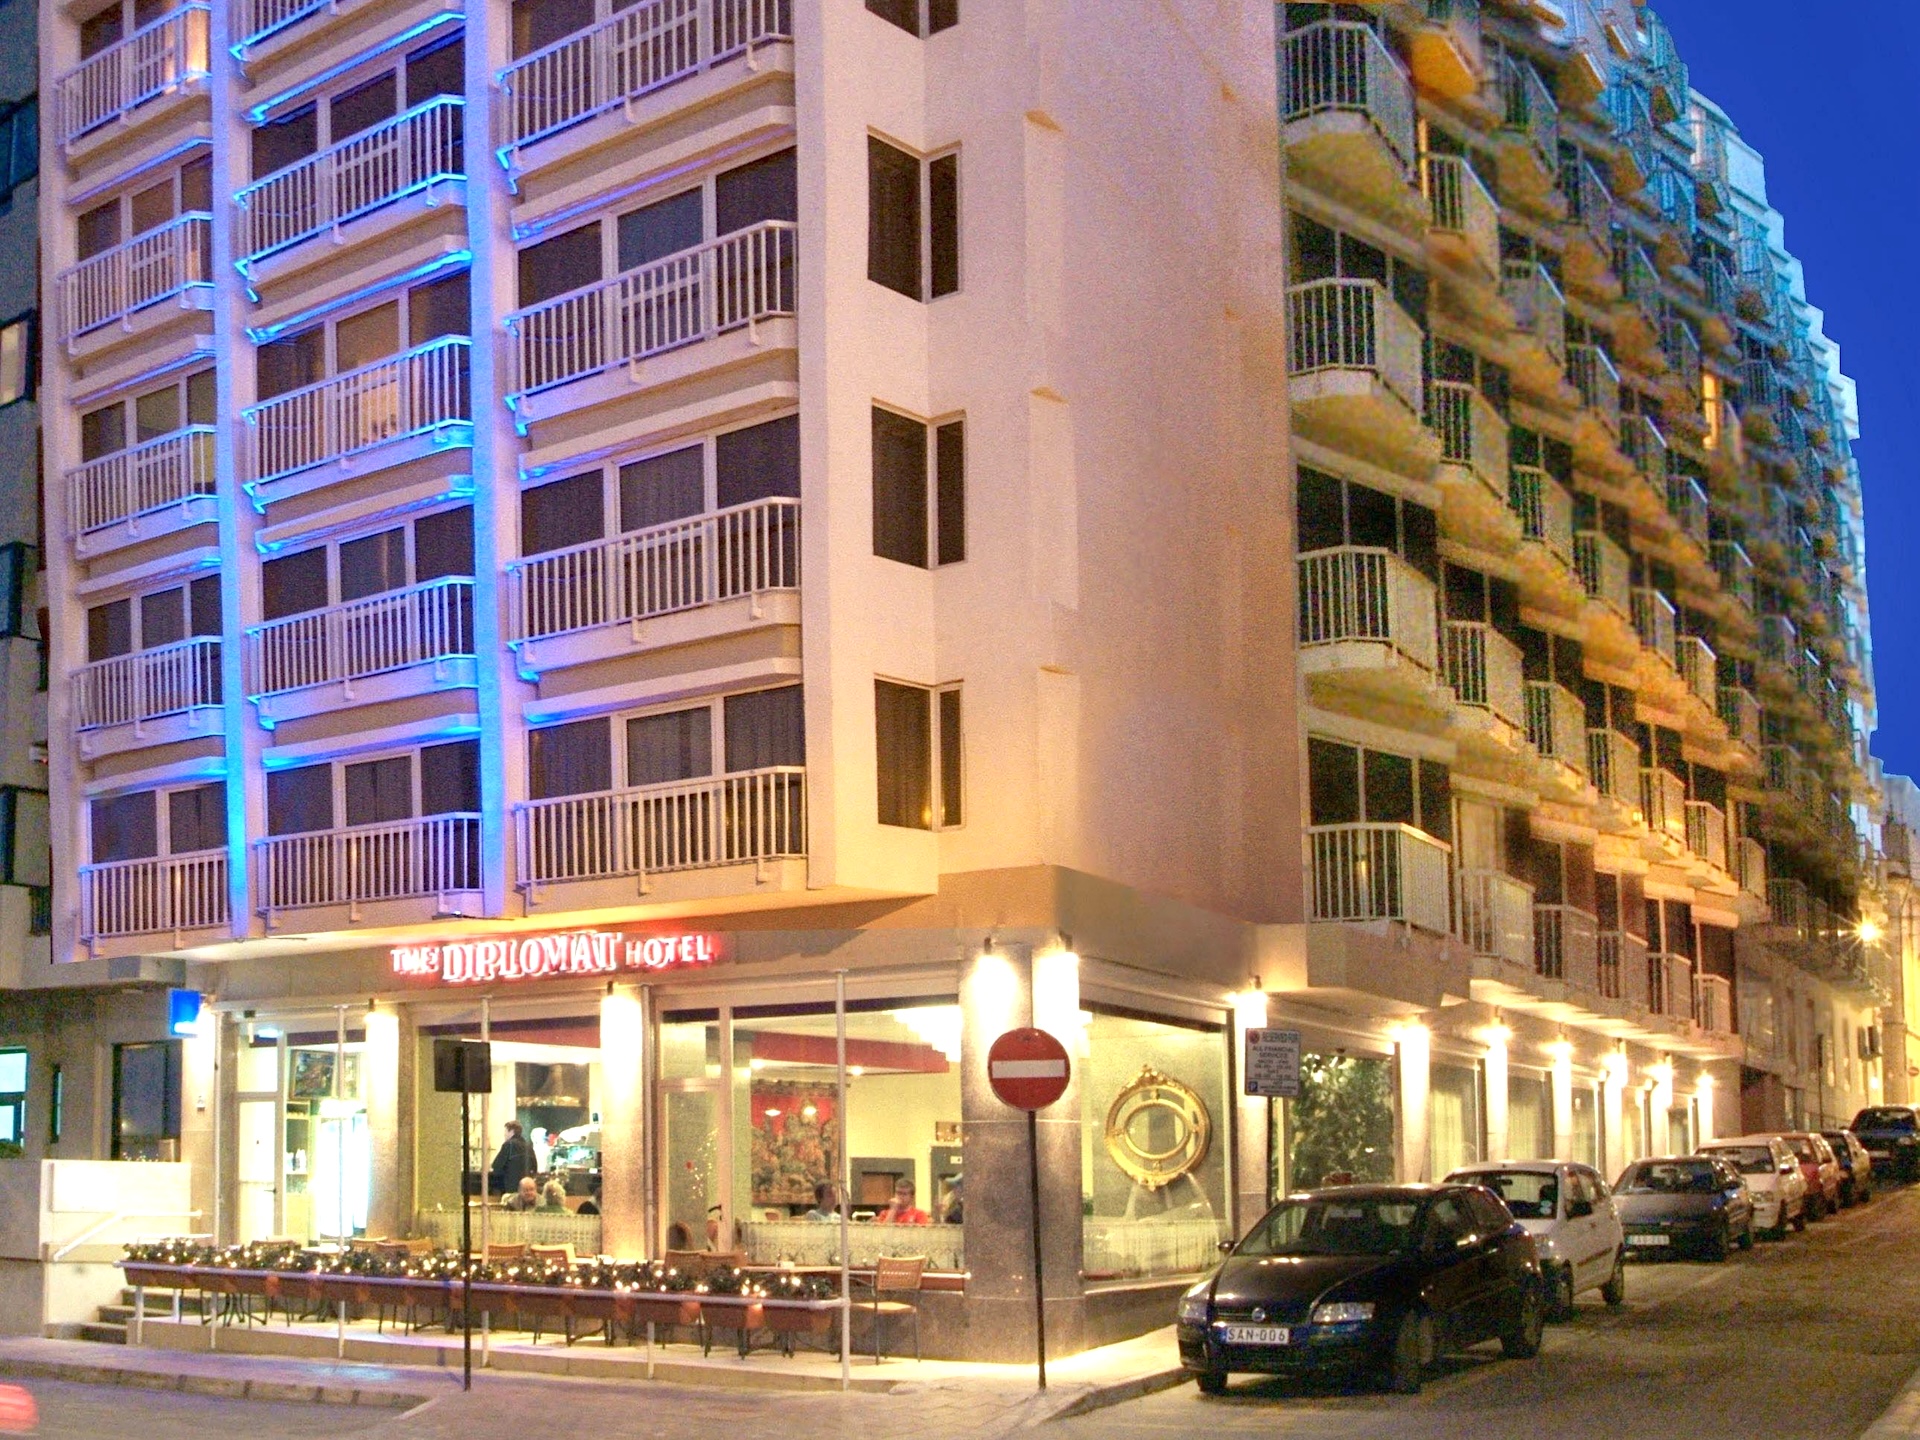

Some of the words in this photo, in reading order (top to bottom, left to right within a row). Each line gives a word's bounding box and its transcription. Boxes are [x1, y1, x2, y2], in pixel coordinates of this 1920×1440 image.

[442, 930, 622, 982] DIPLOMAT
[625, 935, 710, 967] HOTEL
[1228, 1328, 1286, 1341] SAN-006
